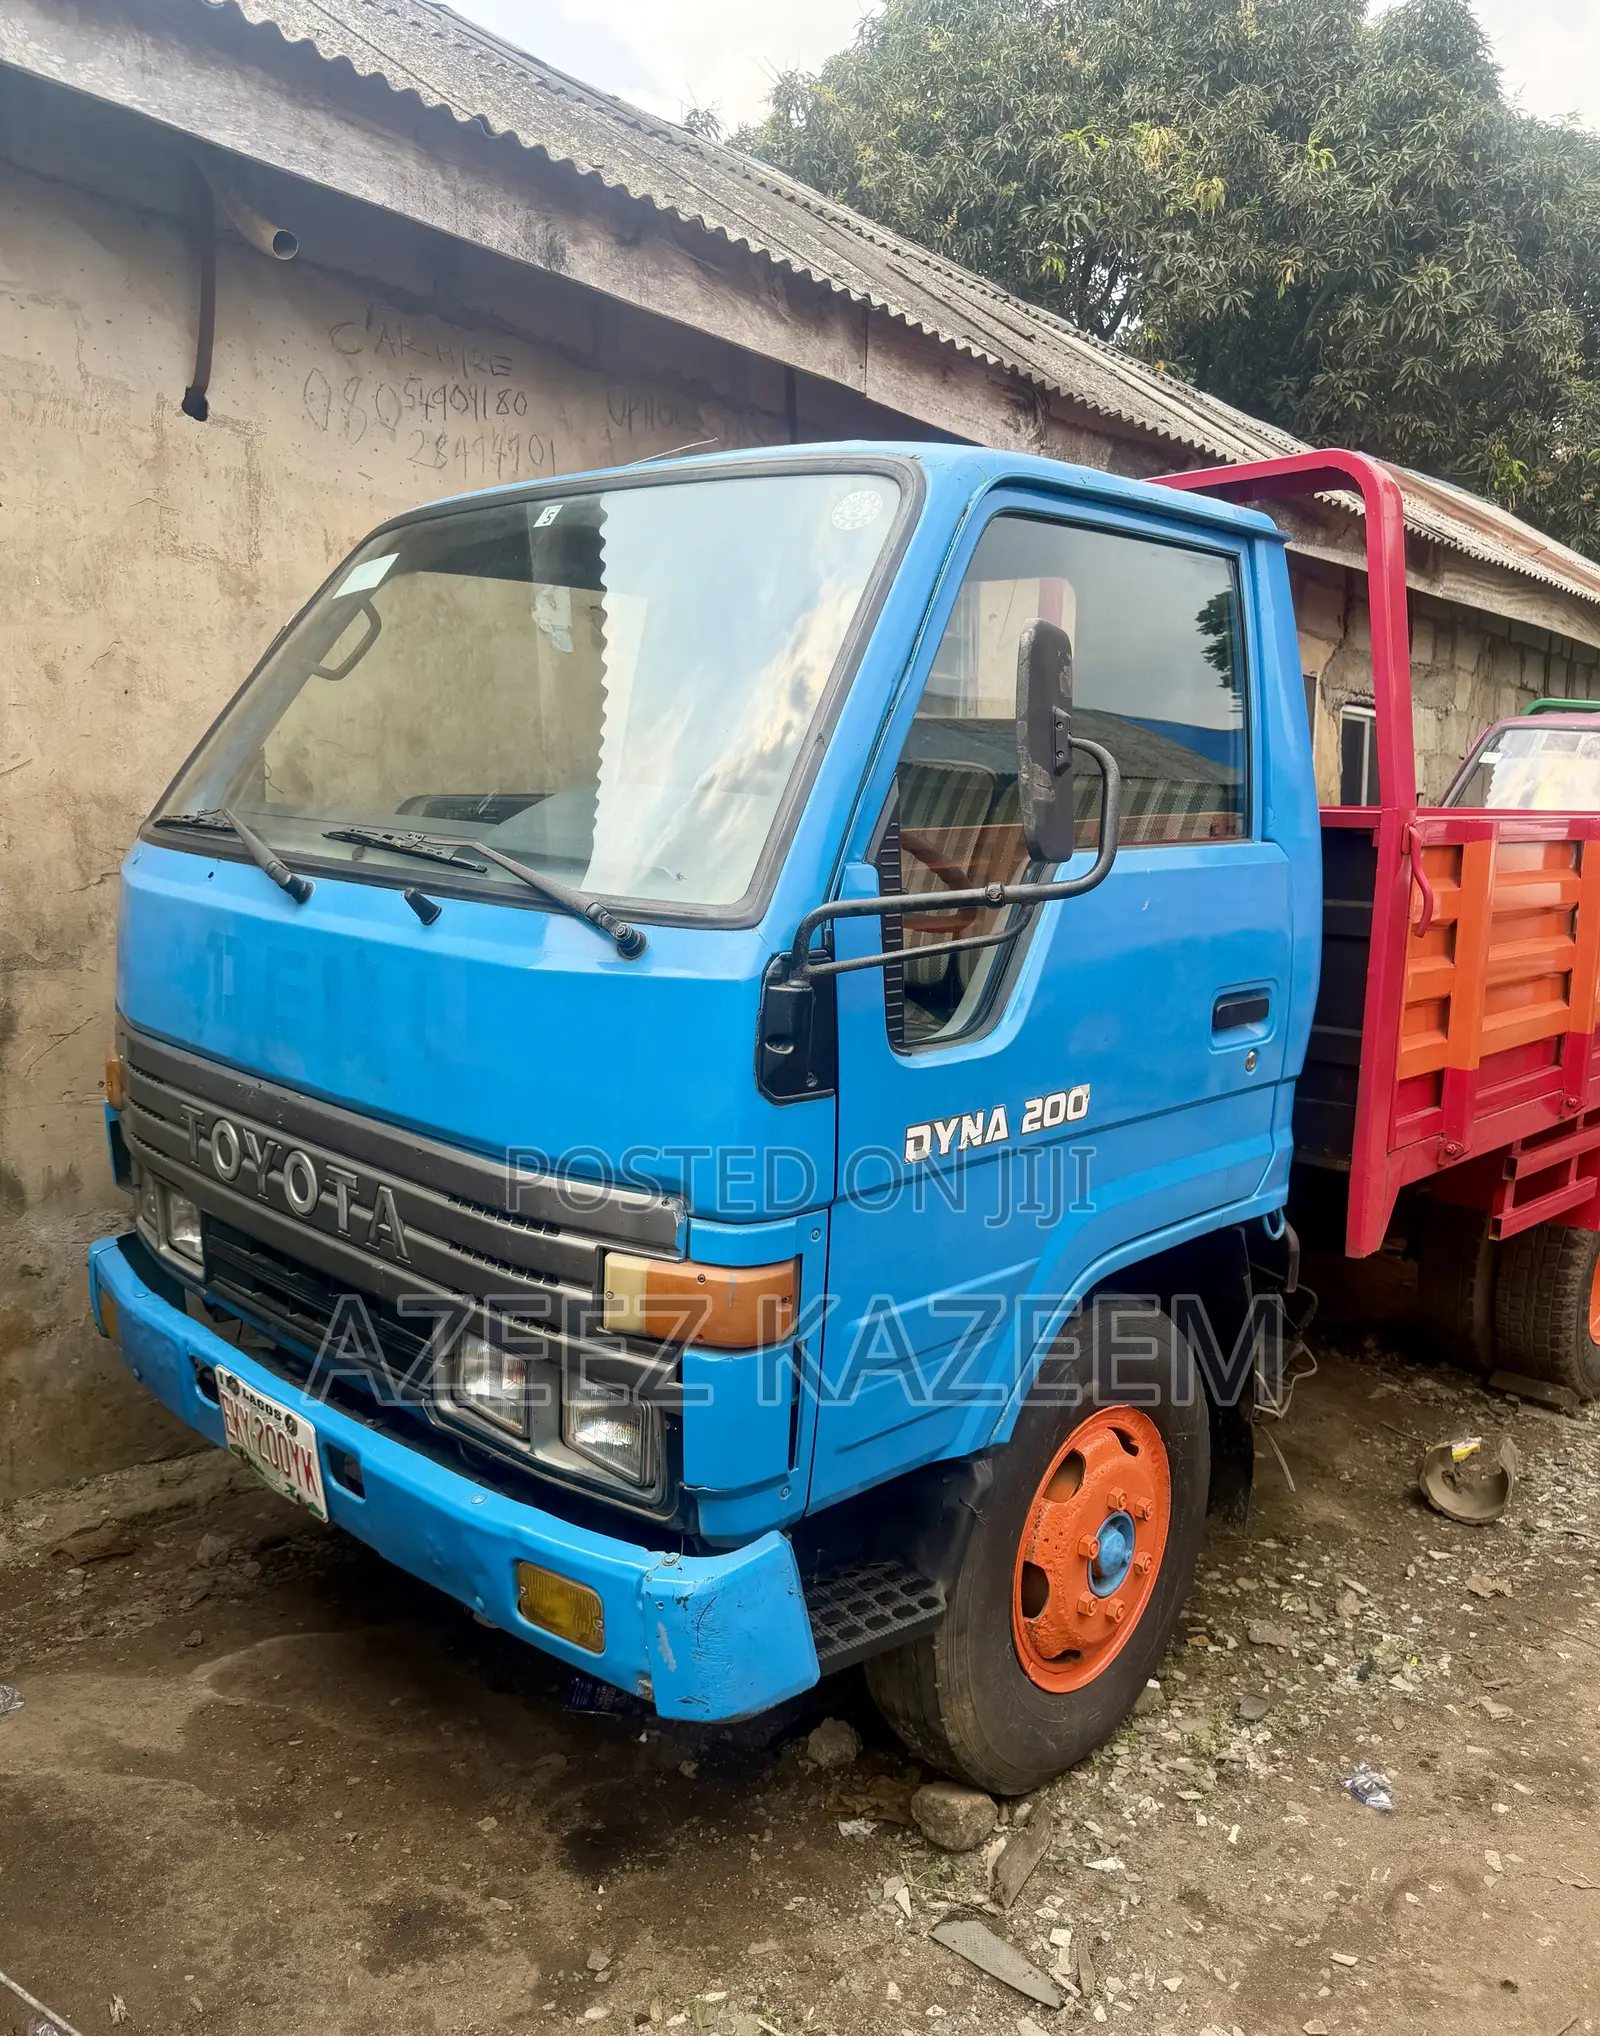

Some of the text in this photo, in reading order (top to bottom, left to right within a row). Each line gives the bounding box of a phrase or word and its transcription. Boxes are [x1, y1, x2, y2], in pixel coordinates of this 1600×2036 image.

[903, 1083, 1091, 1165] DYNA 200
[180, 1102, 412, 1264] TOYOTA
[242, 1387, 283, 1422] LAGOS
